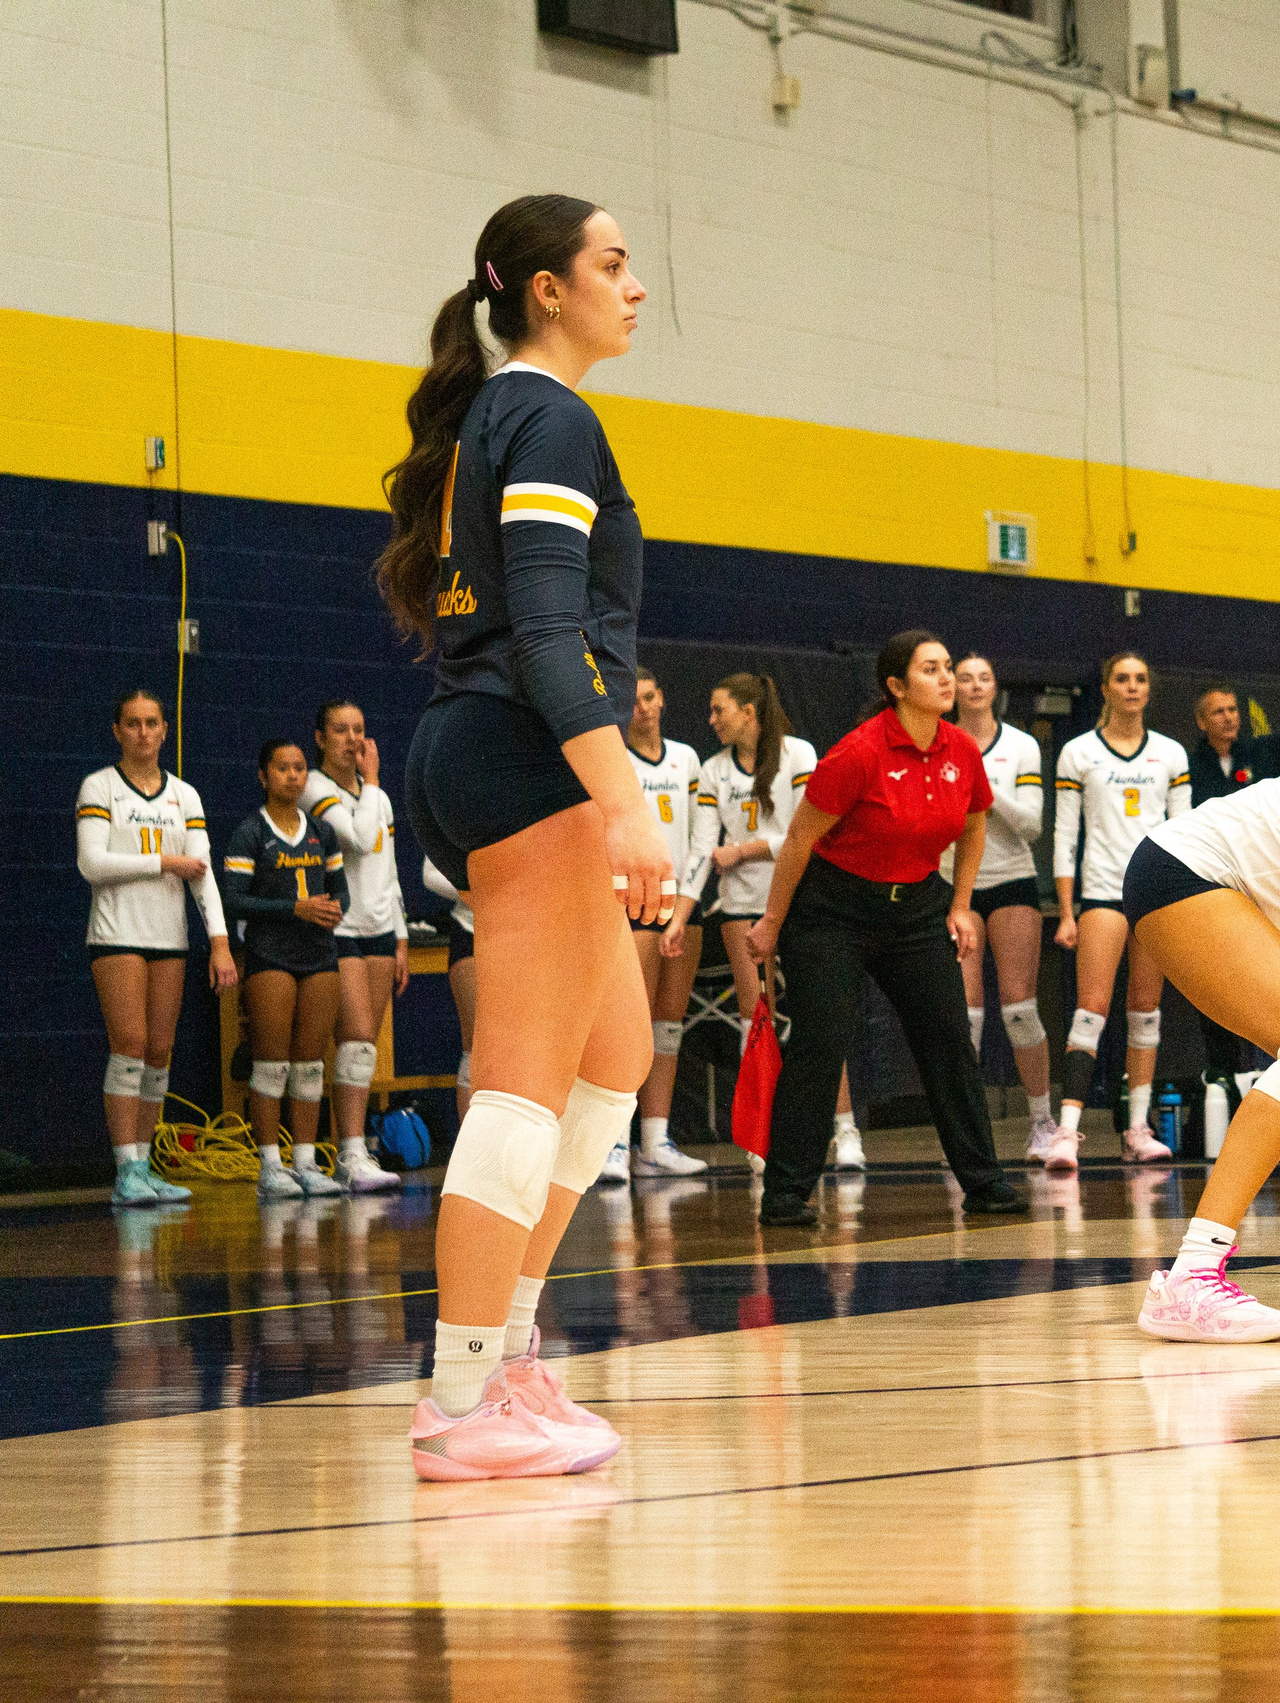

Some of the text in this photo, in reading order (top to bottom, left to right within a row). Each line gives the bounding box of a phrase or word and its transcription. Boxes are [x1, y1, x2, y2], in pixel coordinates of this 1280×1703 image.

[657, 794, 673, 823] 6
[741, 801, 758, 831] 7
[1123, 788, 1140, 817] 2
[140, 827, 162, 855] 11
[295, 867, 309, 901] 1
